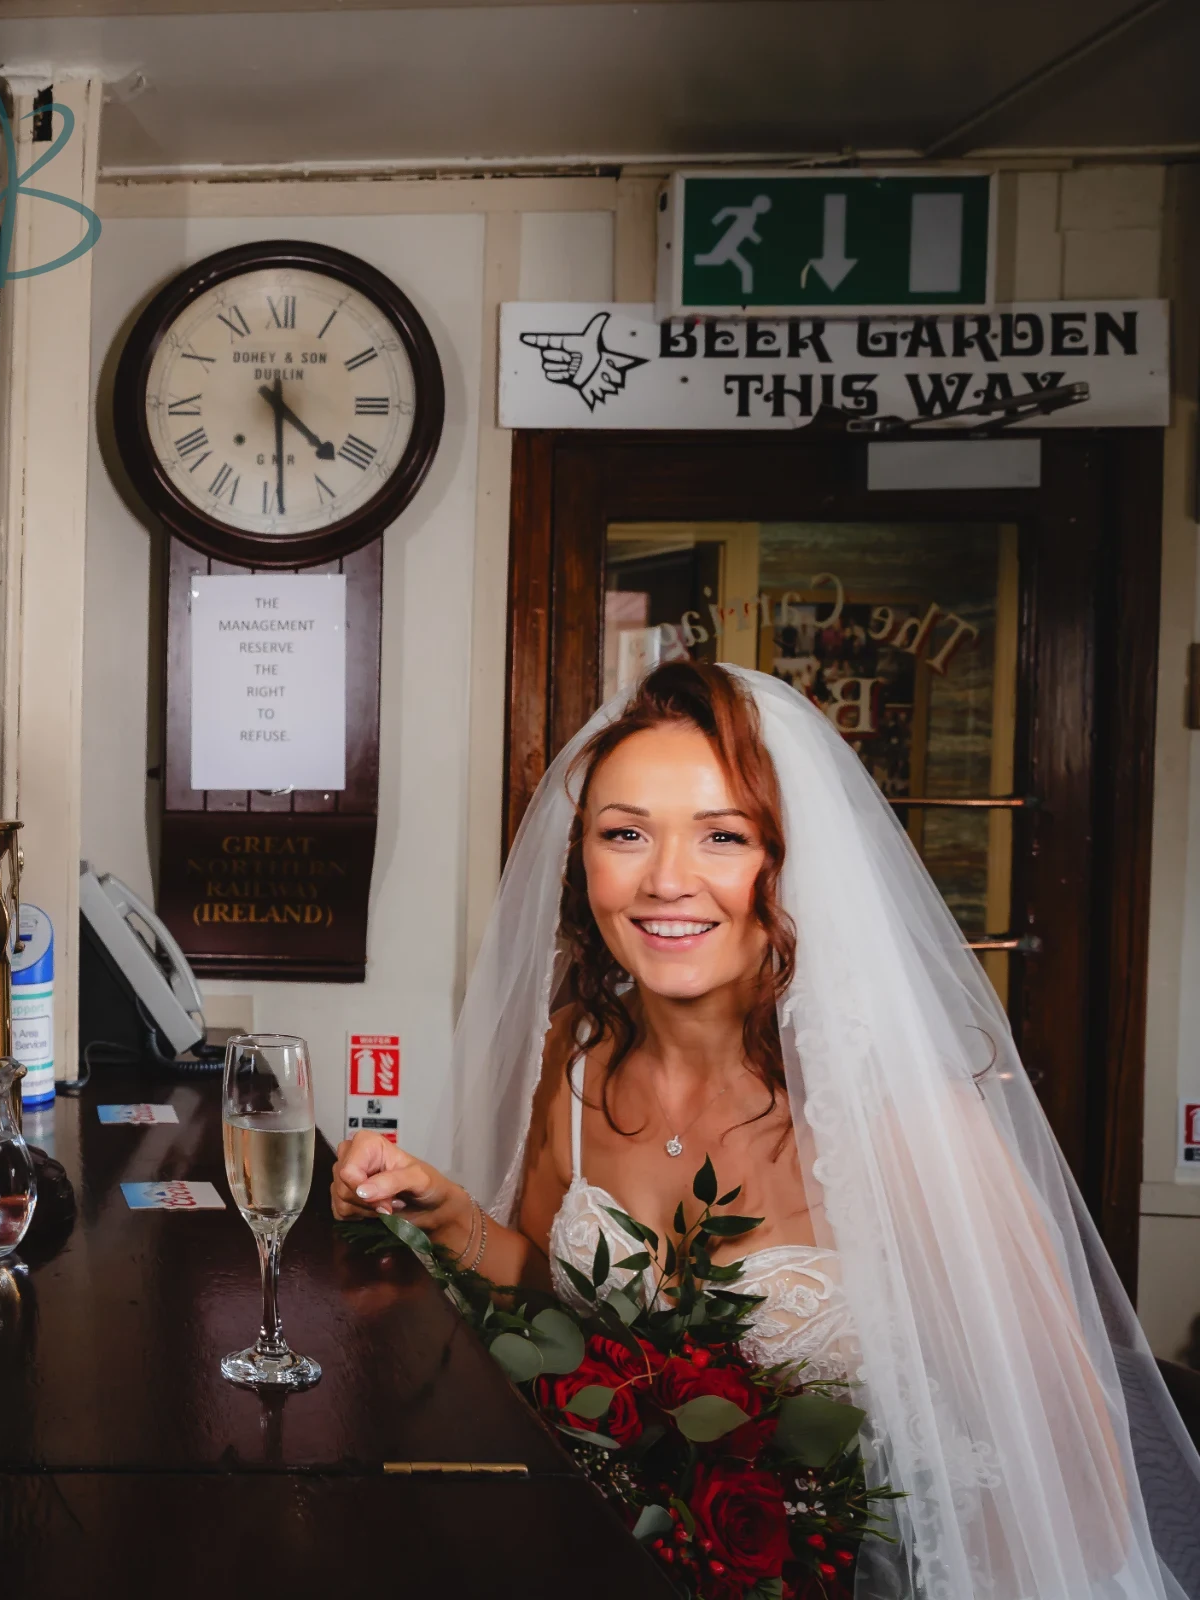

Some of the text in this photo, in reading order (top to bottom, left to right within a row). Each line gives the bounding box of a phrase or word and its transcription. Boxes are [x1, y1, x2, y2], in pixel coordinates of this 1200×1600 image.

[658, 311, 1140, 364] BEER GARDEN
[284, 351, 293, 364] &
[300, 351, 328, 364] SON
[253, 367, 305, 381] DUBLIN
[724, 373, 879, 417] THIS
[255, 597, 279, 609] THE
[218, 619, 315, 631] MANAGEMENT
[239, 641, 294, 653] RESERVE
[254, 663, 279, 676] THE
[246, 685, 286, 698] RIGHT
[257, 707, 275, 720] TO
[240, 729, 291, 742] REFUSE.
[221, 835, 316, 855] GREAT
[206, 879, 319, 899] RAILWAY
[192, 902, 334, 928] (IRELAND)
[11, 1003, 45, 1017] upport
[359, 1036, 392, 1045] WATER
